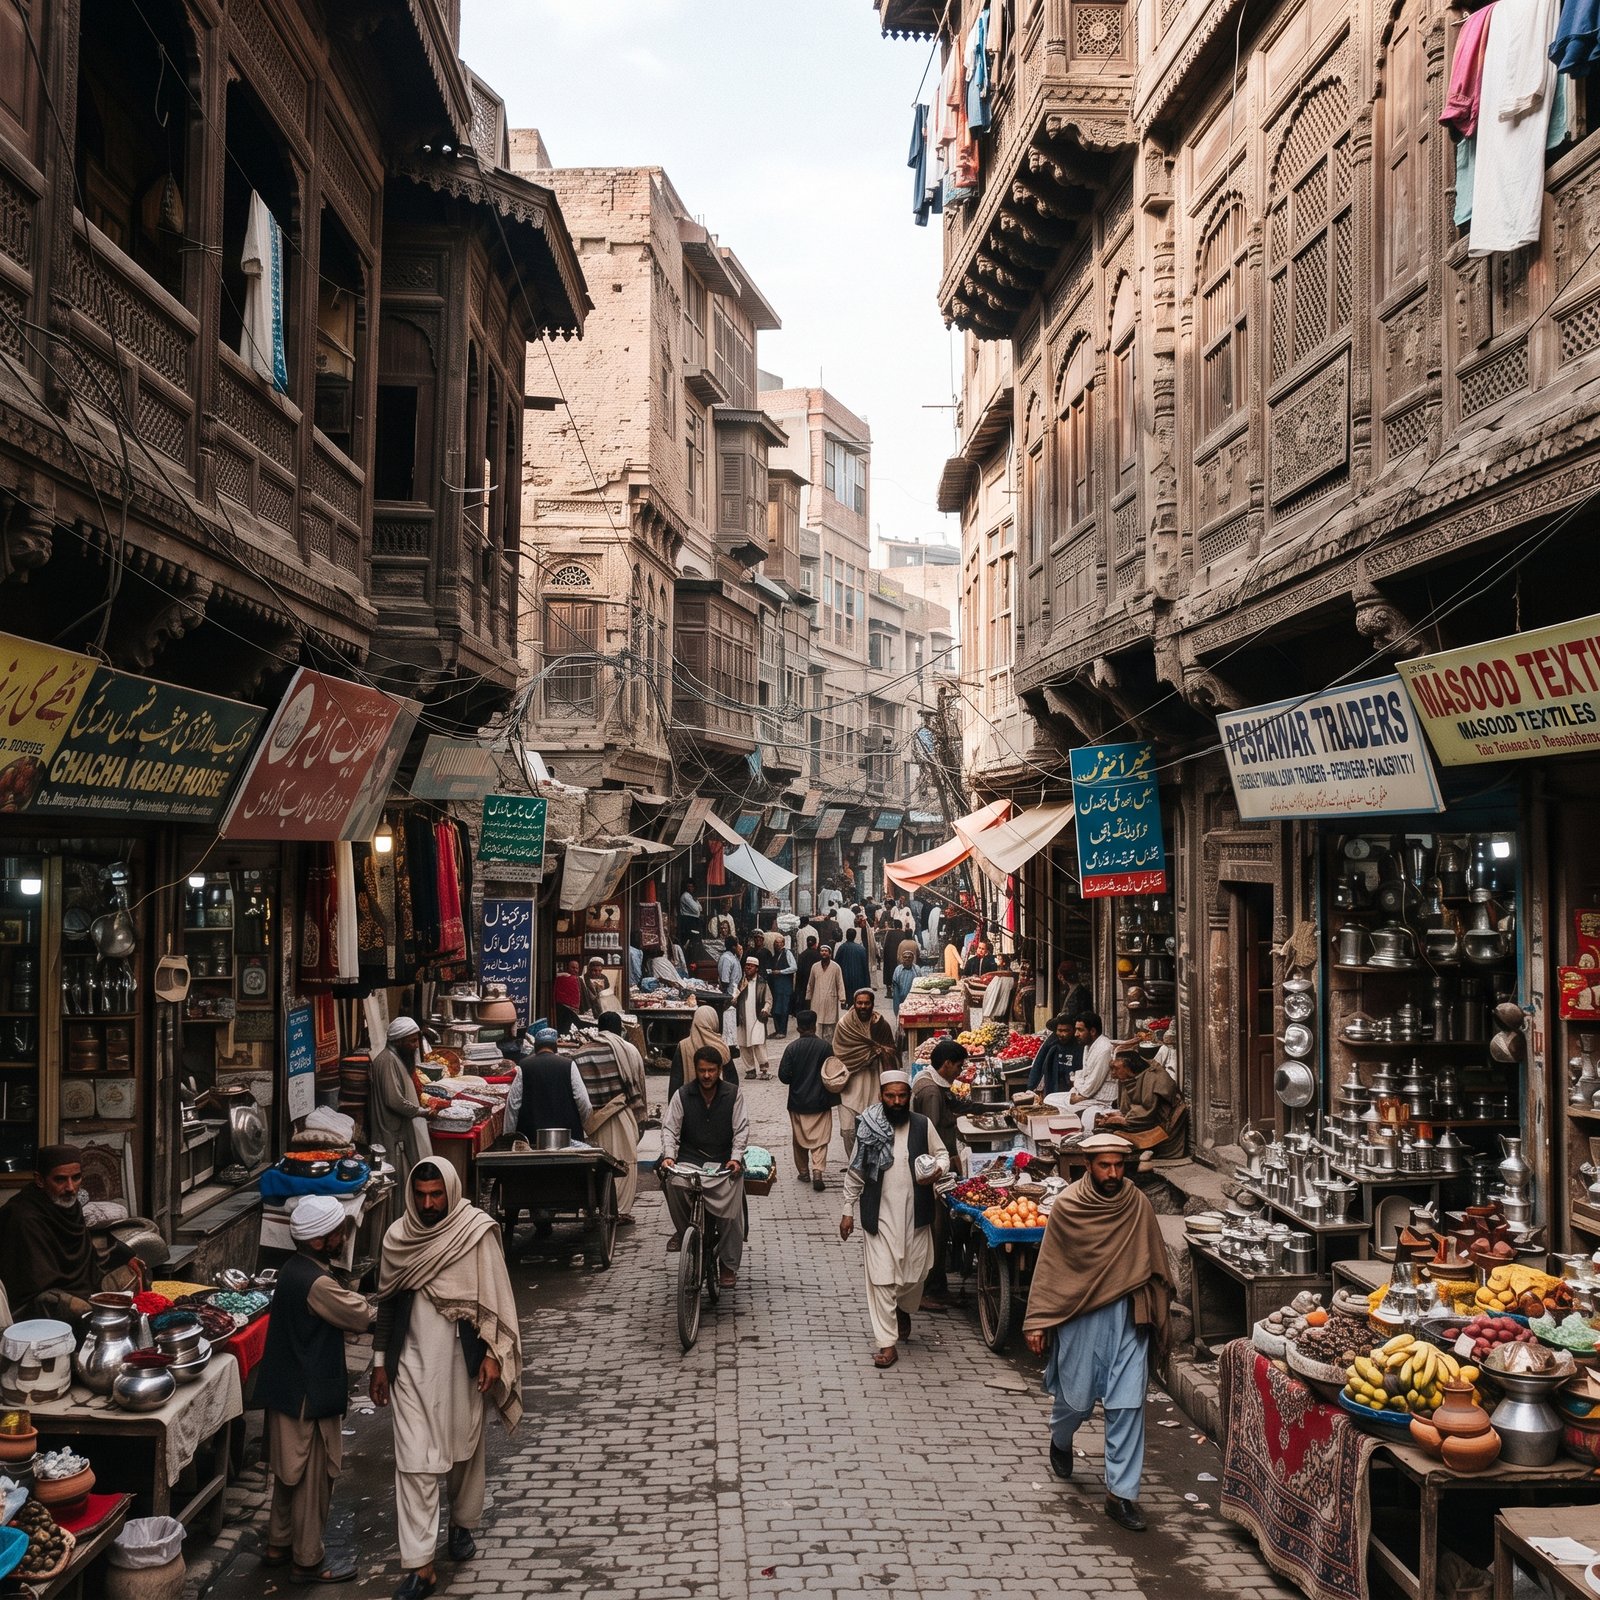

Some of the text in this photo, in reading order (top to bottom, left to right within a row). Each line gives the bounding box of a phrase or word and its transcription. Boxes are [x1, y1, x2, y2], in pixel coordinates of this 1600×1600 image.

[1411, 635, 1600, 720] MASOOD TEXTI
[1224, 709, 1316, 767] PESHAWAR
[1312, 690, 1410, 755] TRADERS
[1457, 714, 1518, 740] MASOOD
[1515, 702, 1597, 731] TEXTILES
[50, 749, 231, 798] CHACHA KABAB HOUSE
